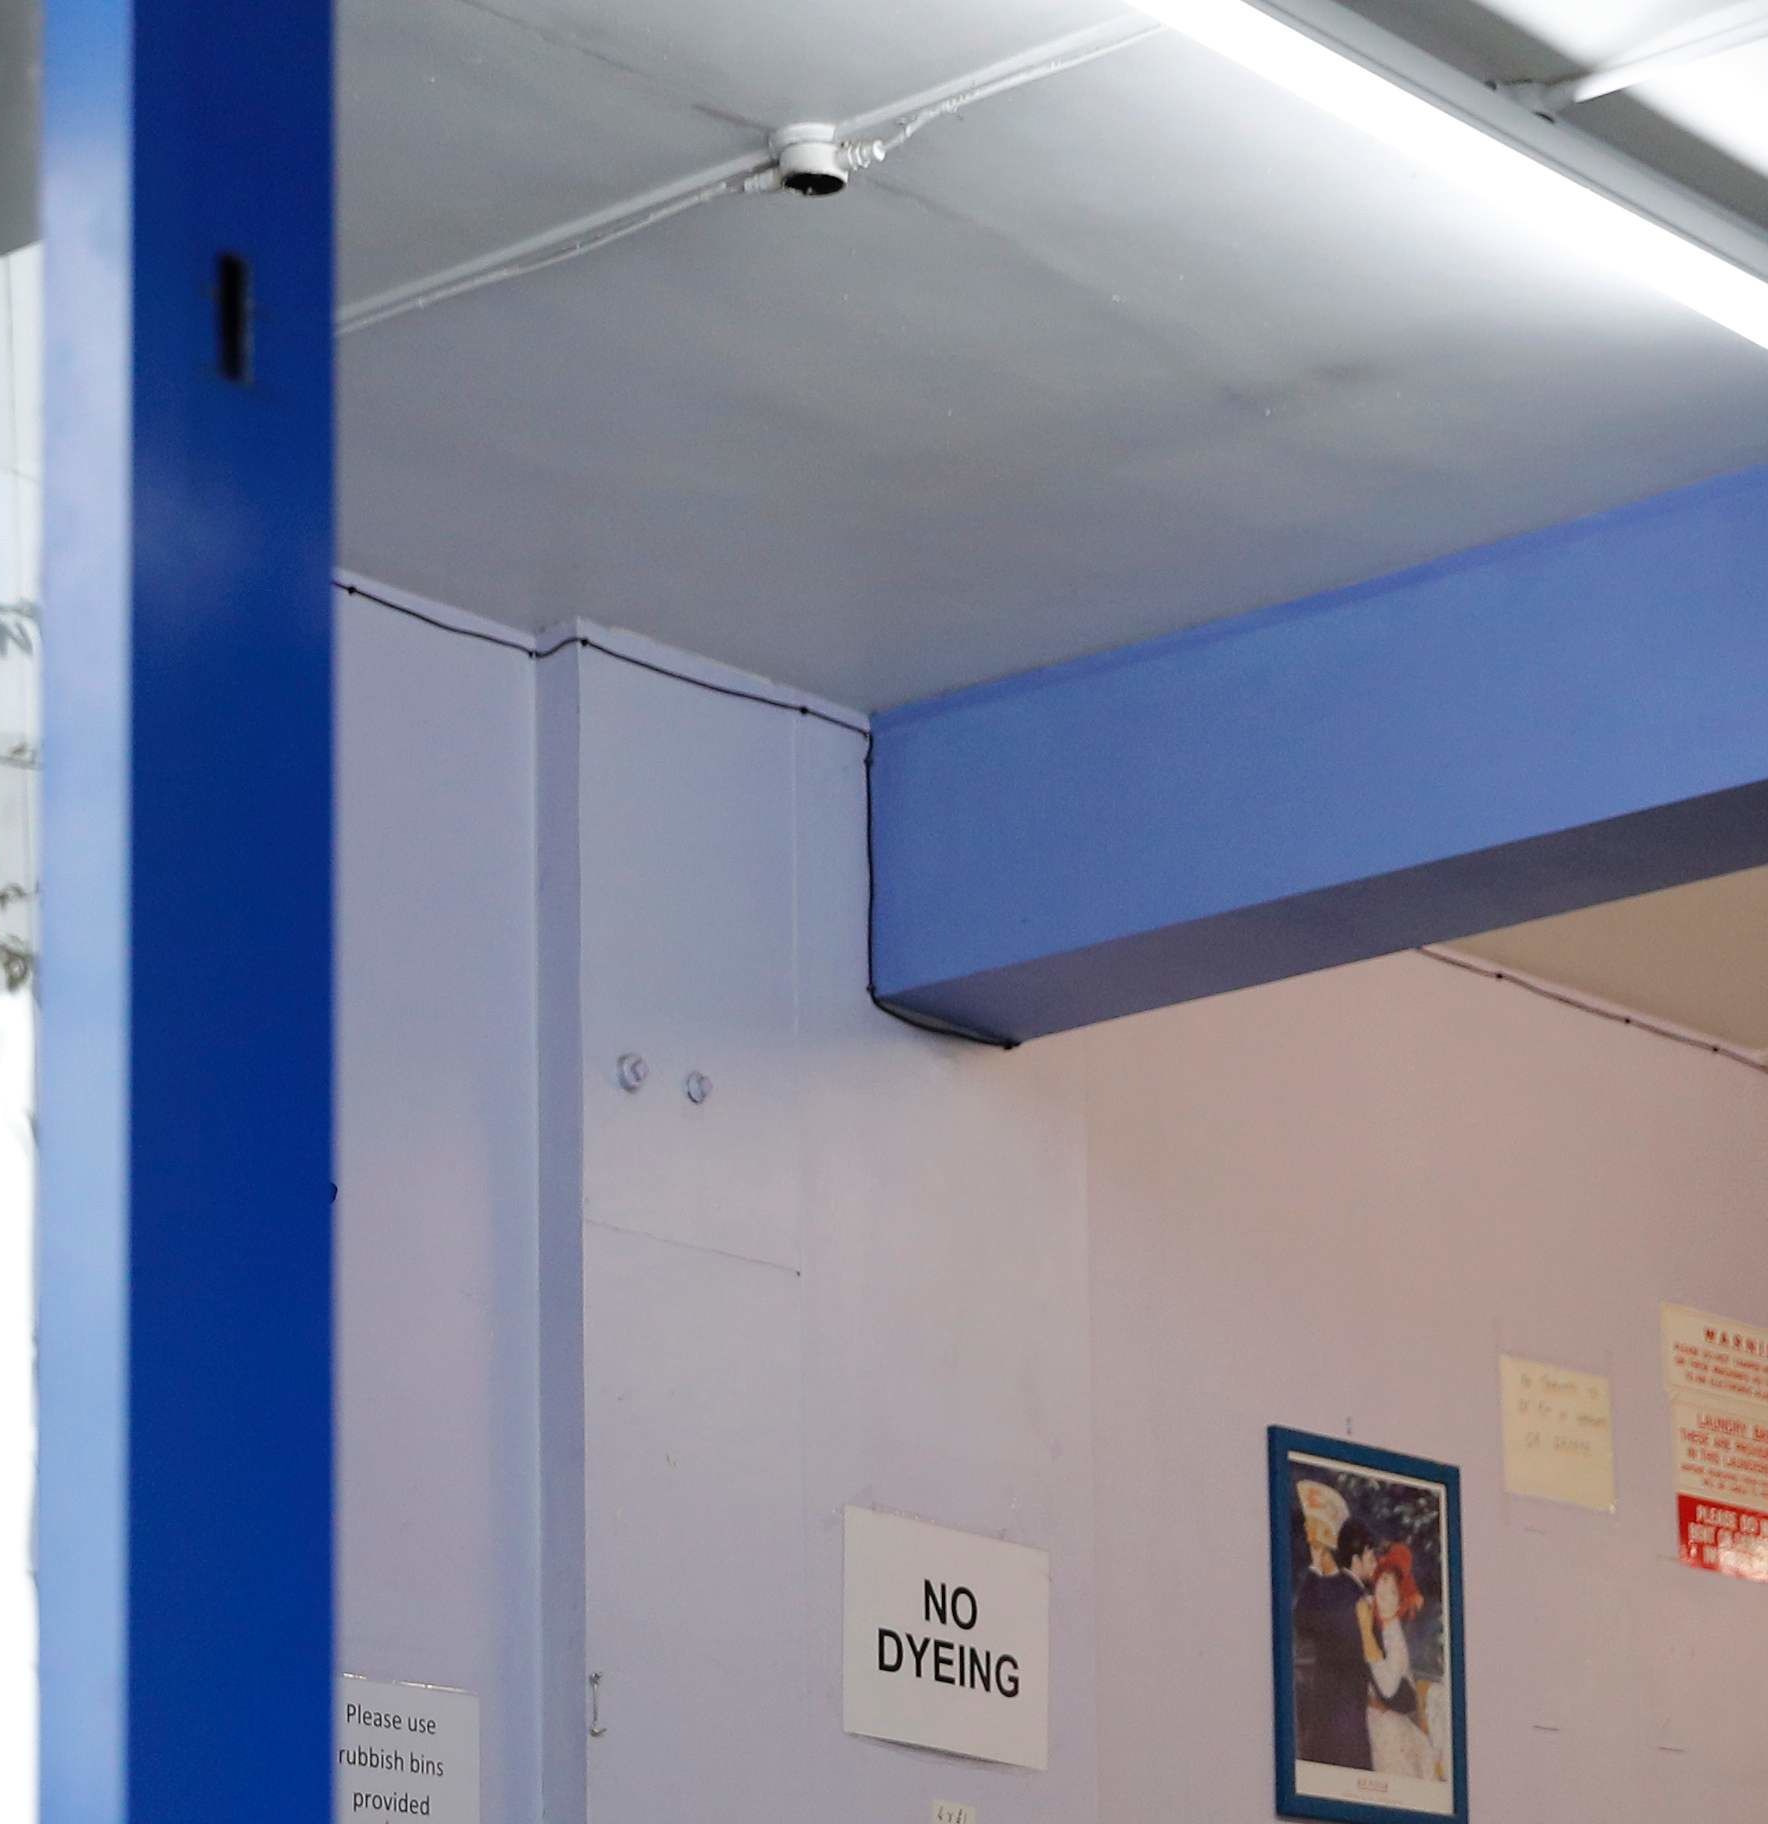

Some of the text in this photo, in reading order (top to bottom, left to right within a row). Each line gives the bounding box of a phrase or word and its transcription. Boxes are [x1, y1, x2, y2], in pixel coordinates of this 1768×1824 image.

[923, 1578, 978, 1630] NO
[877, 1627, 1020, 1698] DYEING
[346, 1703, 437, 1735] Please use
[338, 1745, 445, 1777] rubbish bins
[352, 1791, 430, 1816] provided
